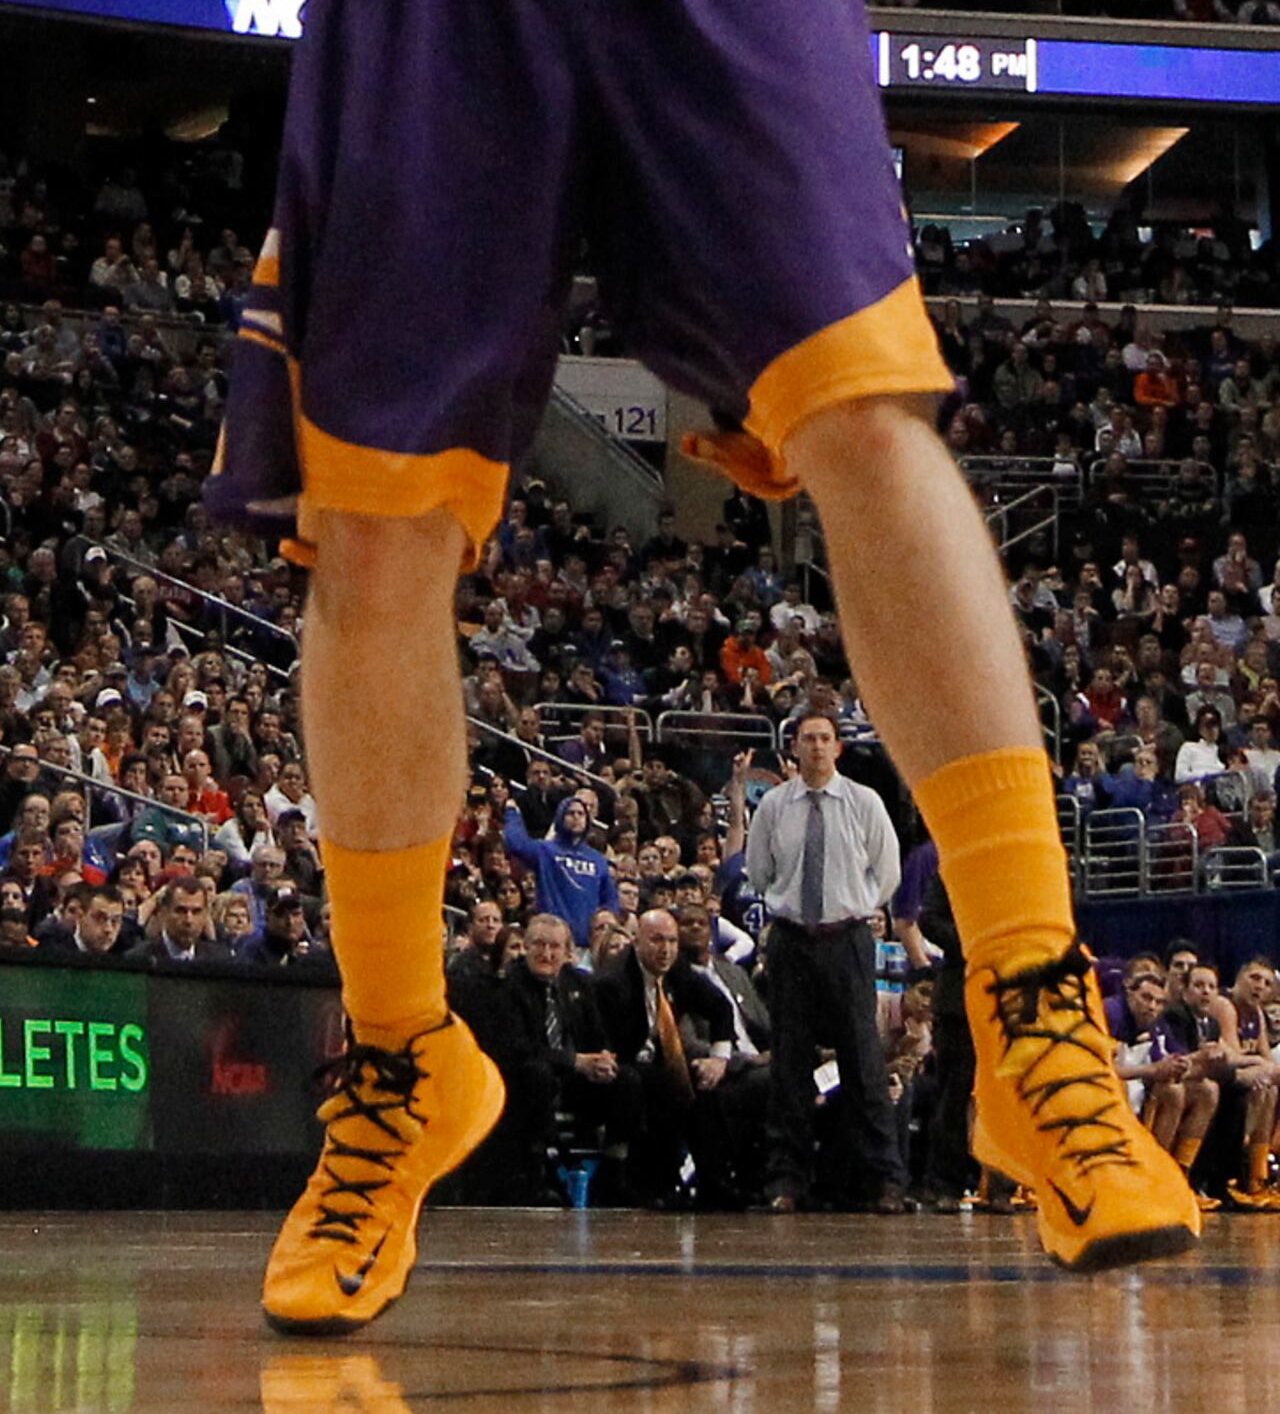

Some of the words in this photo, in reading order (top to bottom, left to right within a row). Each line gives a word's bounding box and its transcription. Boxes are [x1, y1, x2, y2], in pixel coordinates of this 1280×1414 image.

[901, 44, 981, 81] 1:48
[991, 53, 1028, 77] PM
[614, 406, 657, 435] 121
